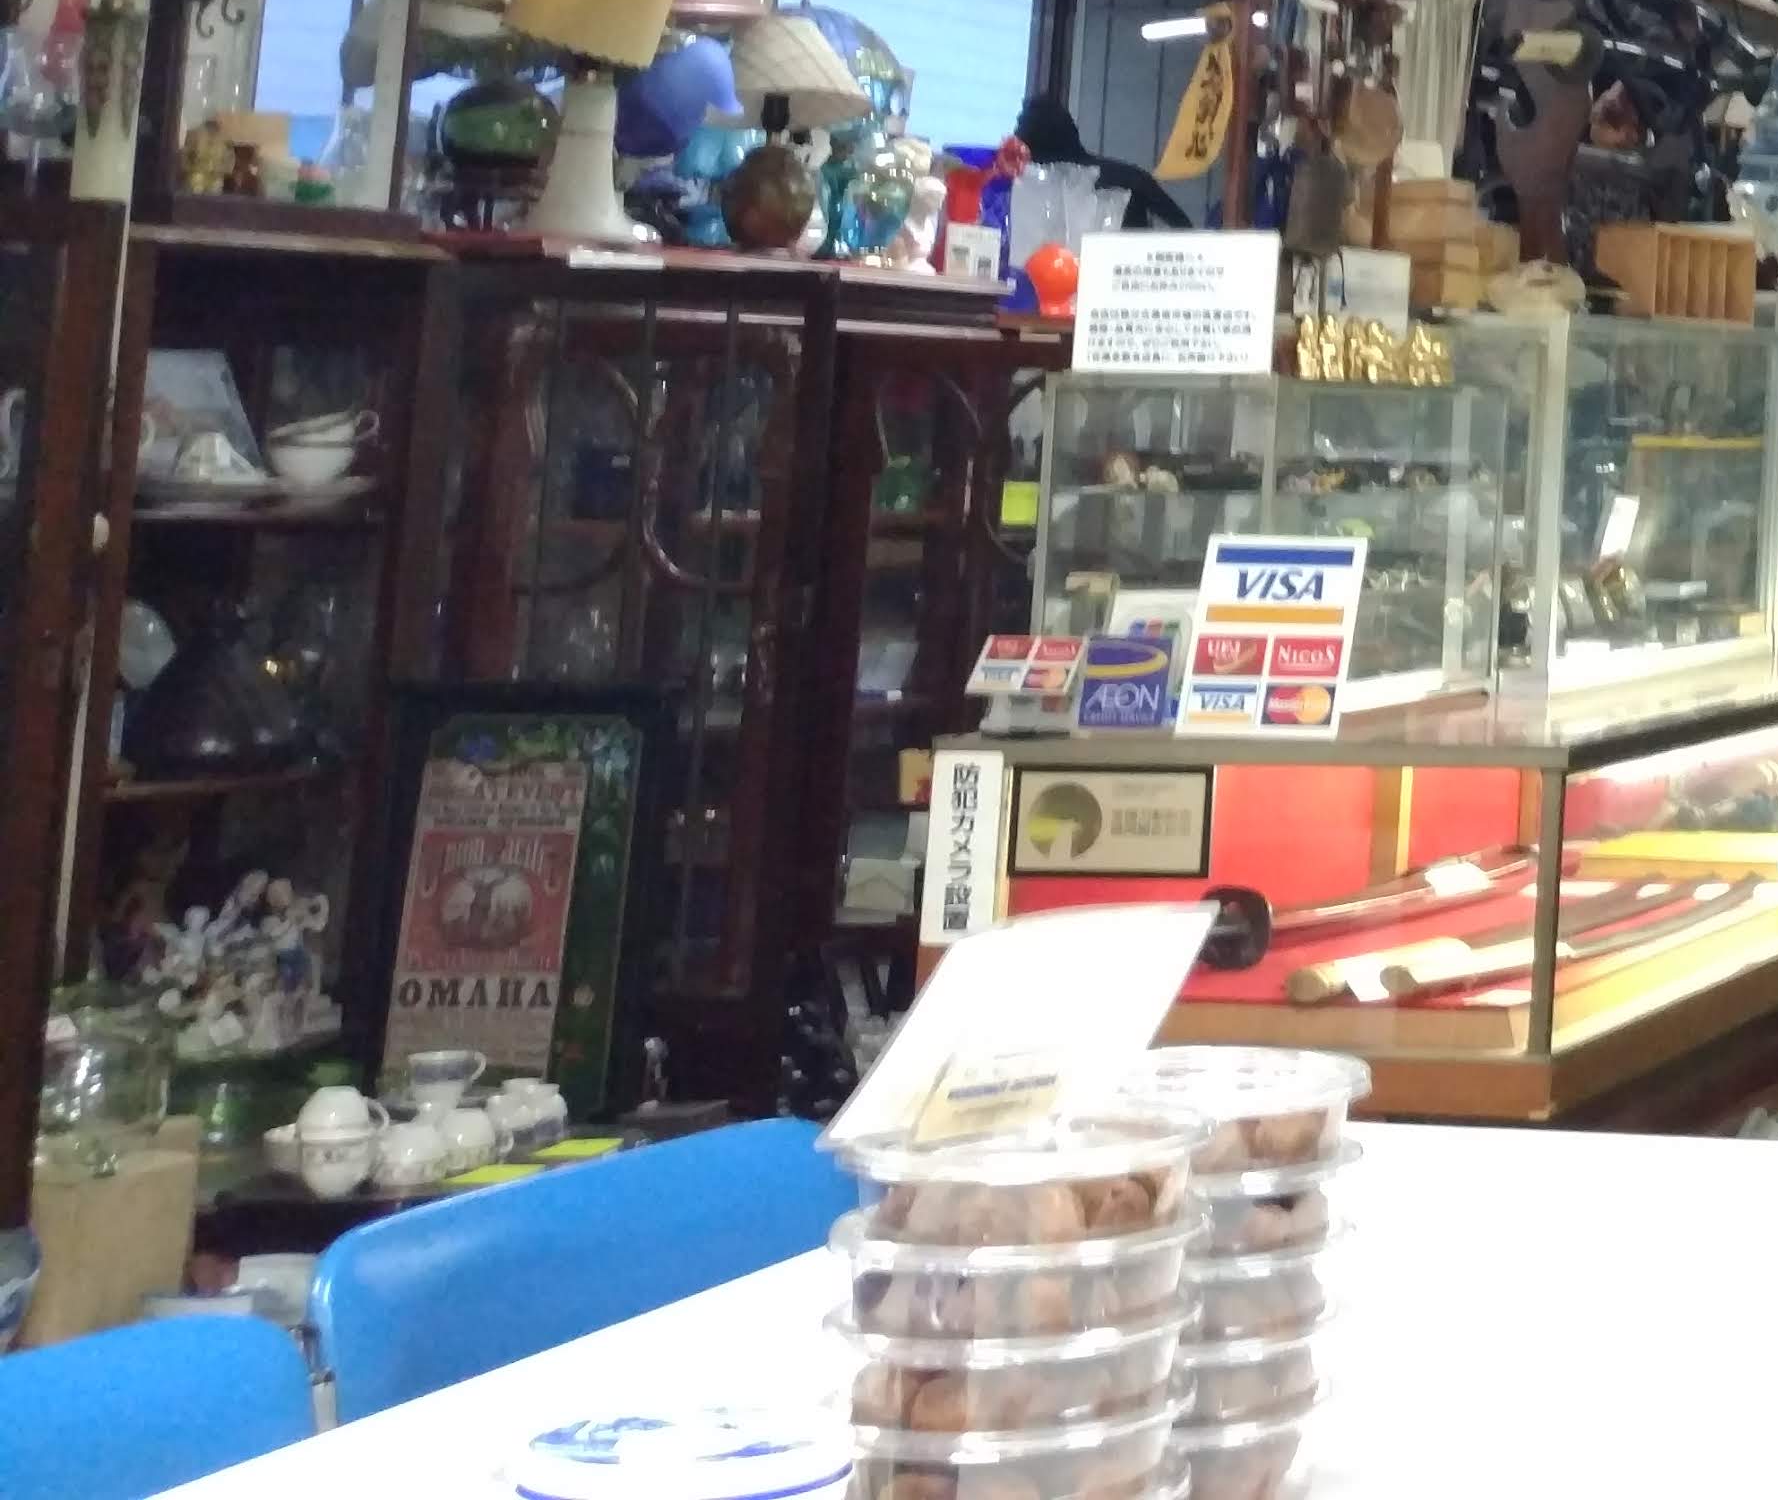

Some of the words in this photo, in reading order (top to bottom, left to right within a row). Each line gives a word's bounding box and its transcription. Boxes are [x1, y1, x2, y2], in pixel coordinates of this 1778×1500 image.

[1236, 568, 1325, 602] VISA
[1277, 643, 1336, 665] NICOS
[1200, 692, 1245, 711] VISA
[943, 762, 979, 930] 防犯カメラ設置
[398, 977, 552, 1010] OMAHA
